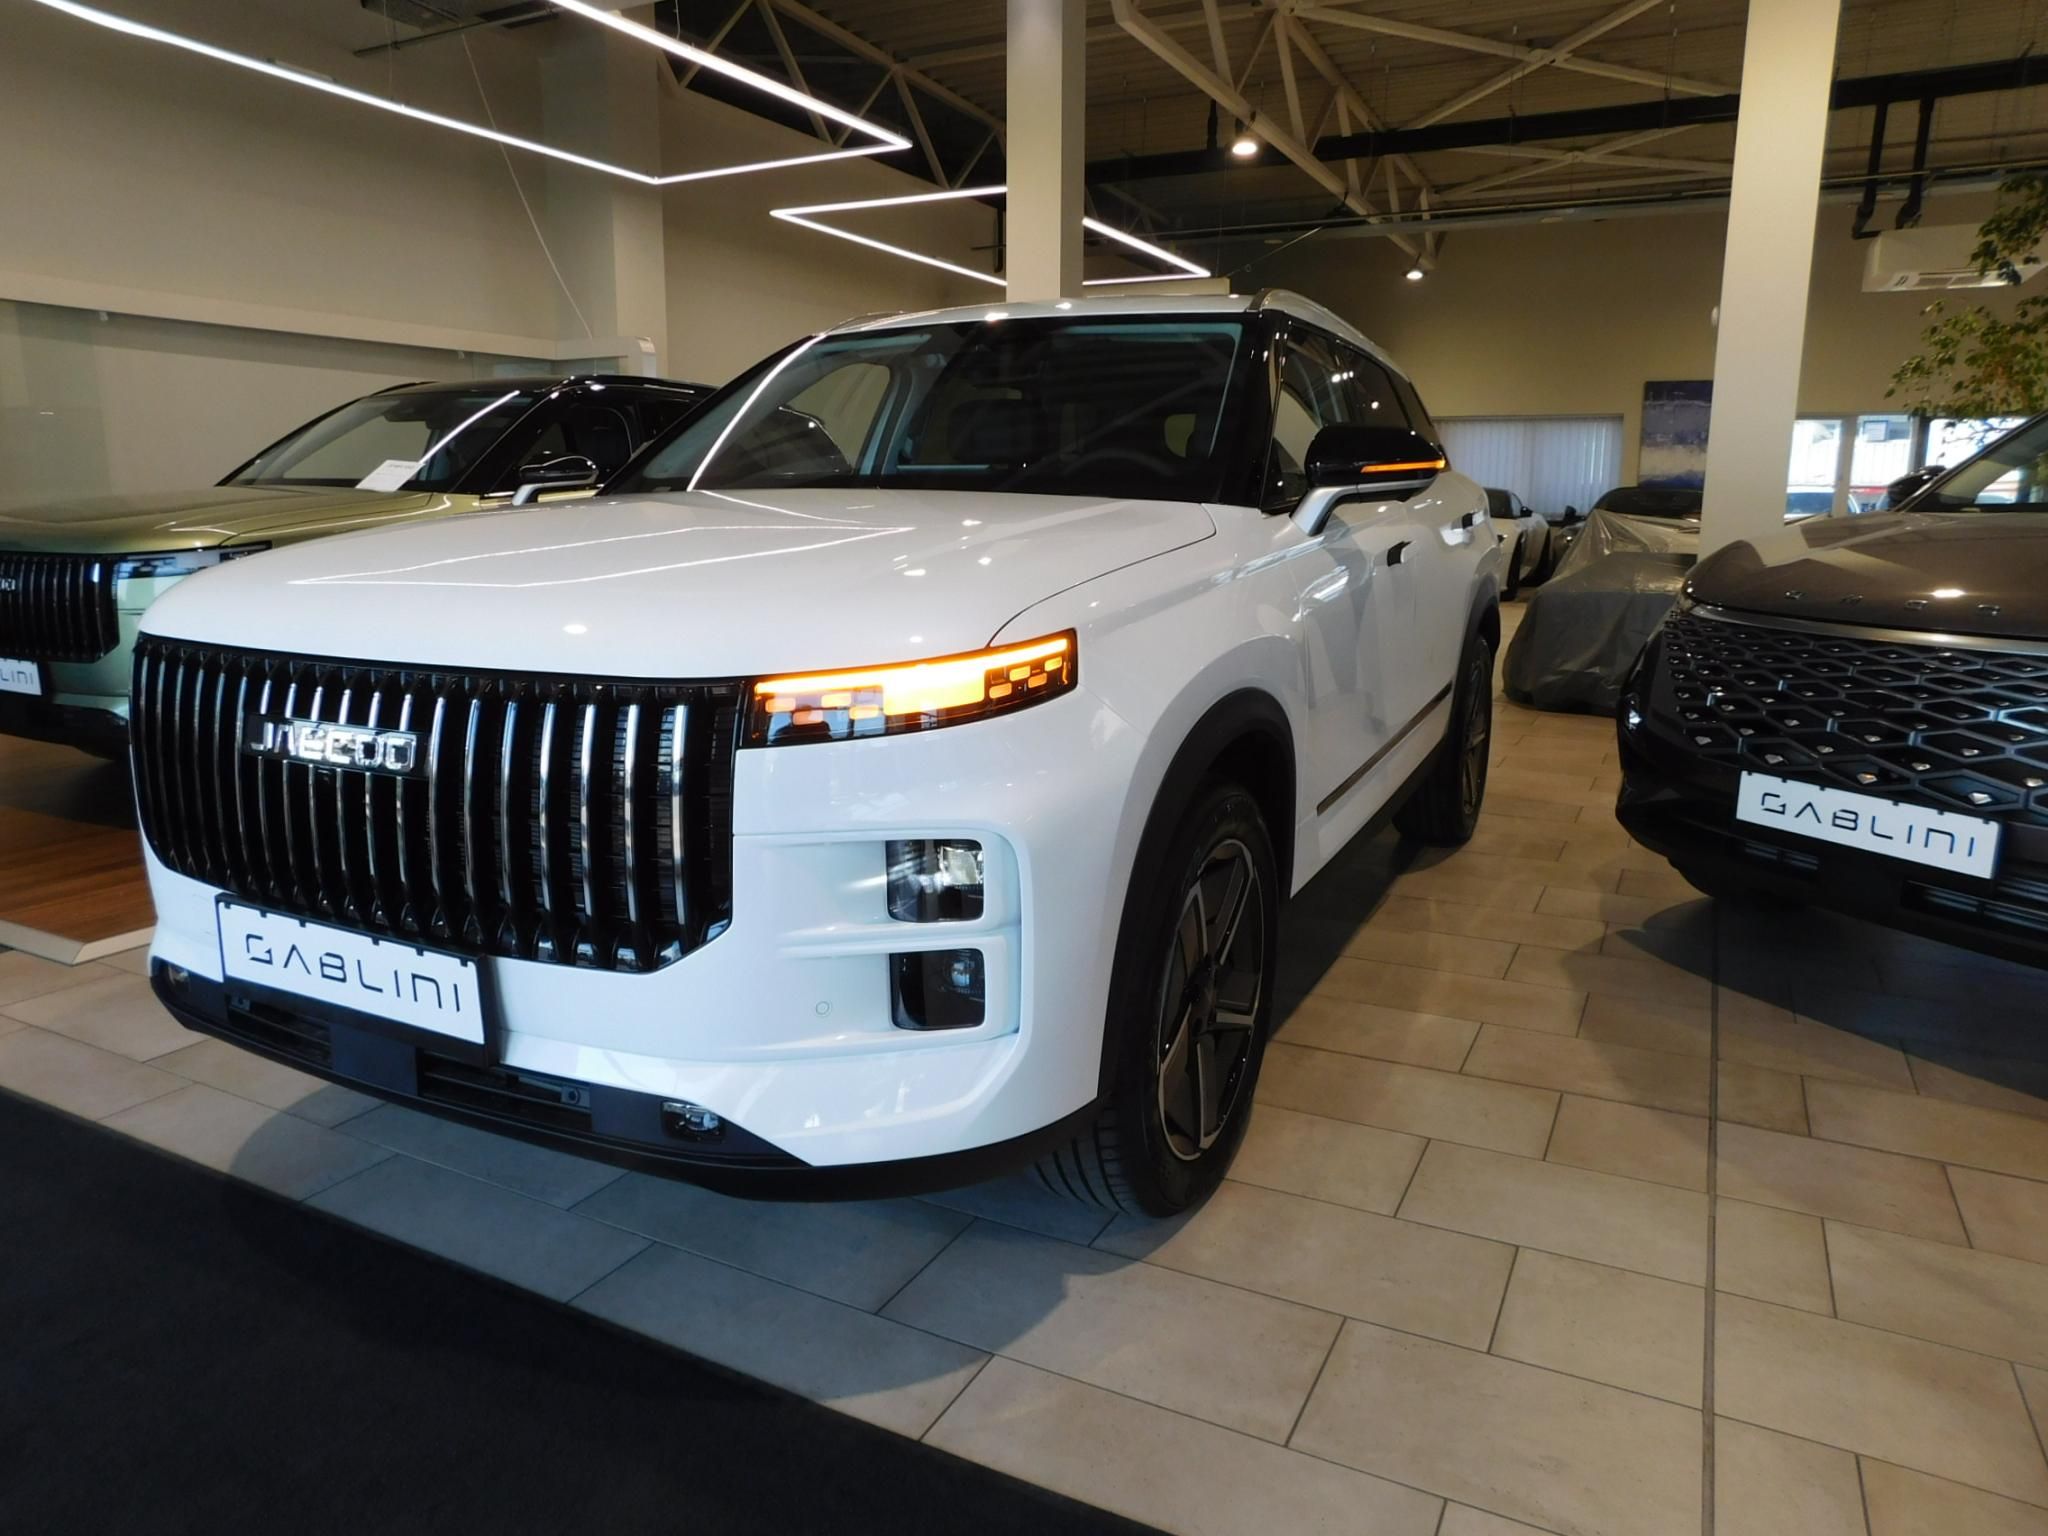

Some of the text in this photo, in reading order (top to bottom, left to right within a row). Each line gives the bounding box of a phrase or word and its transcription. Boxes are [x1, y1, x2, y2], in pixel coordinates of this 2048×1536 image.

[250, 721, 417, 771] JAECOO
[1761, 792, 1975, 857] GABLINI
[245, 933, 462, 1012] GABLINI
